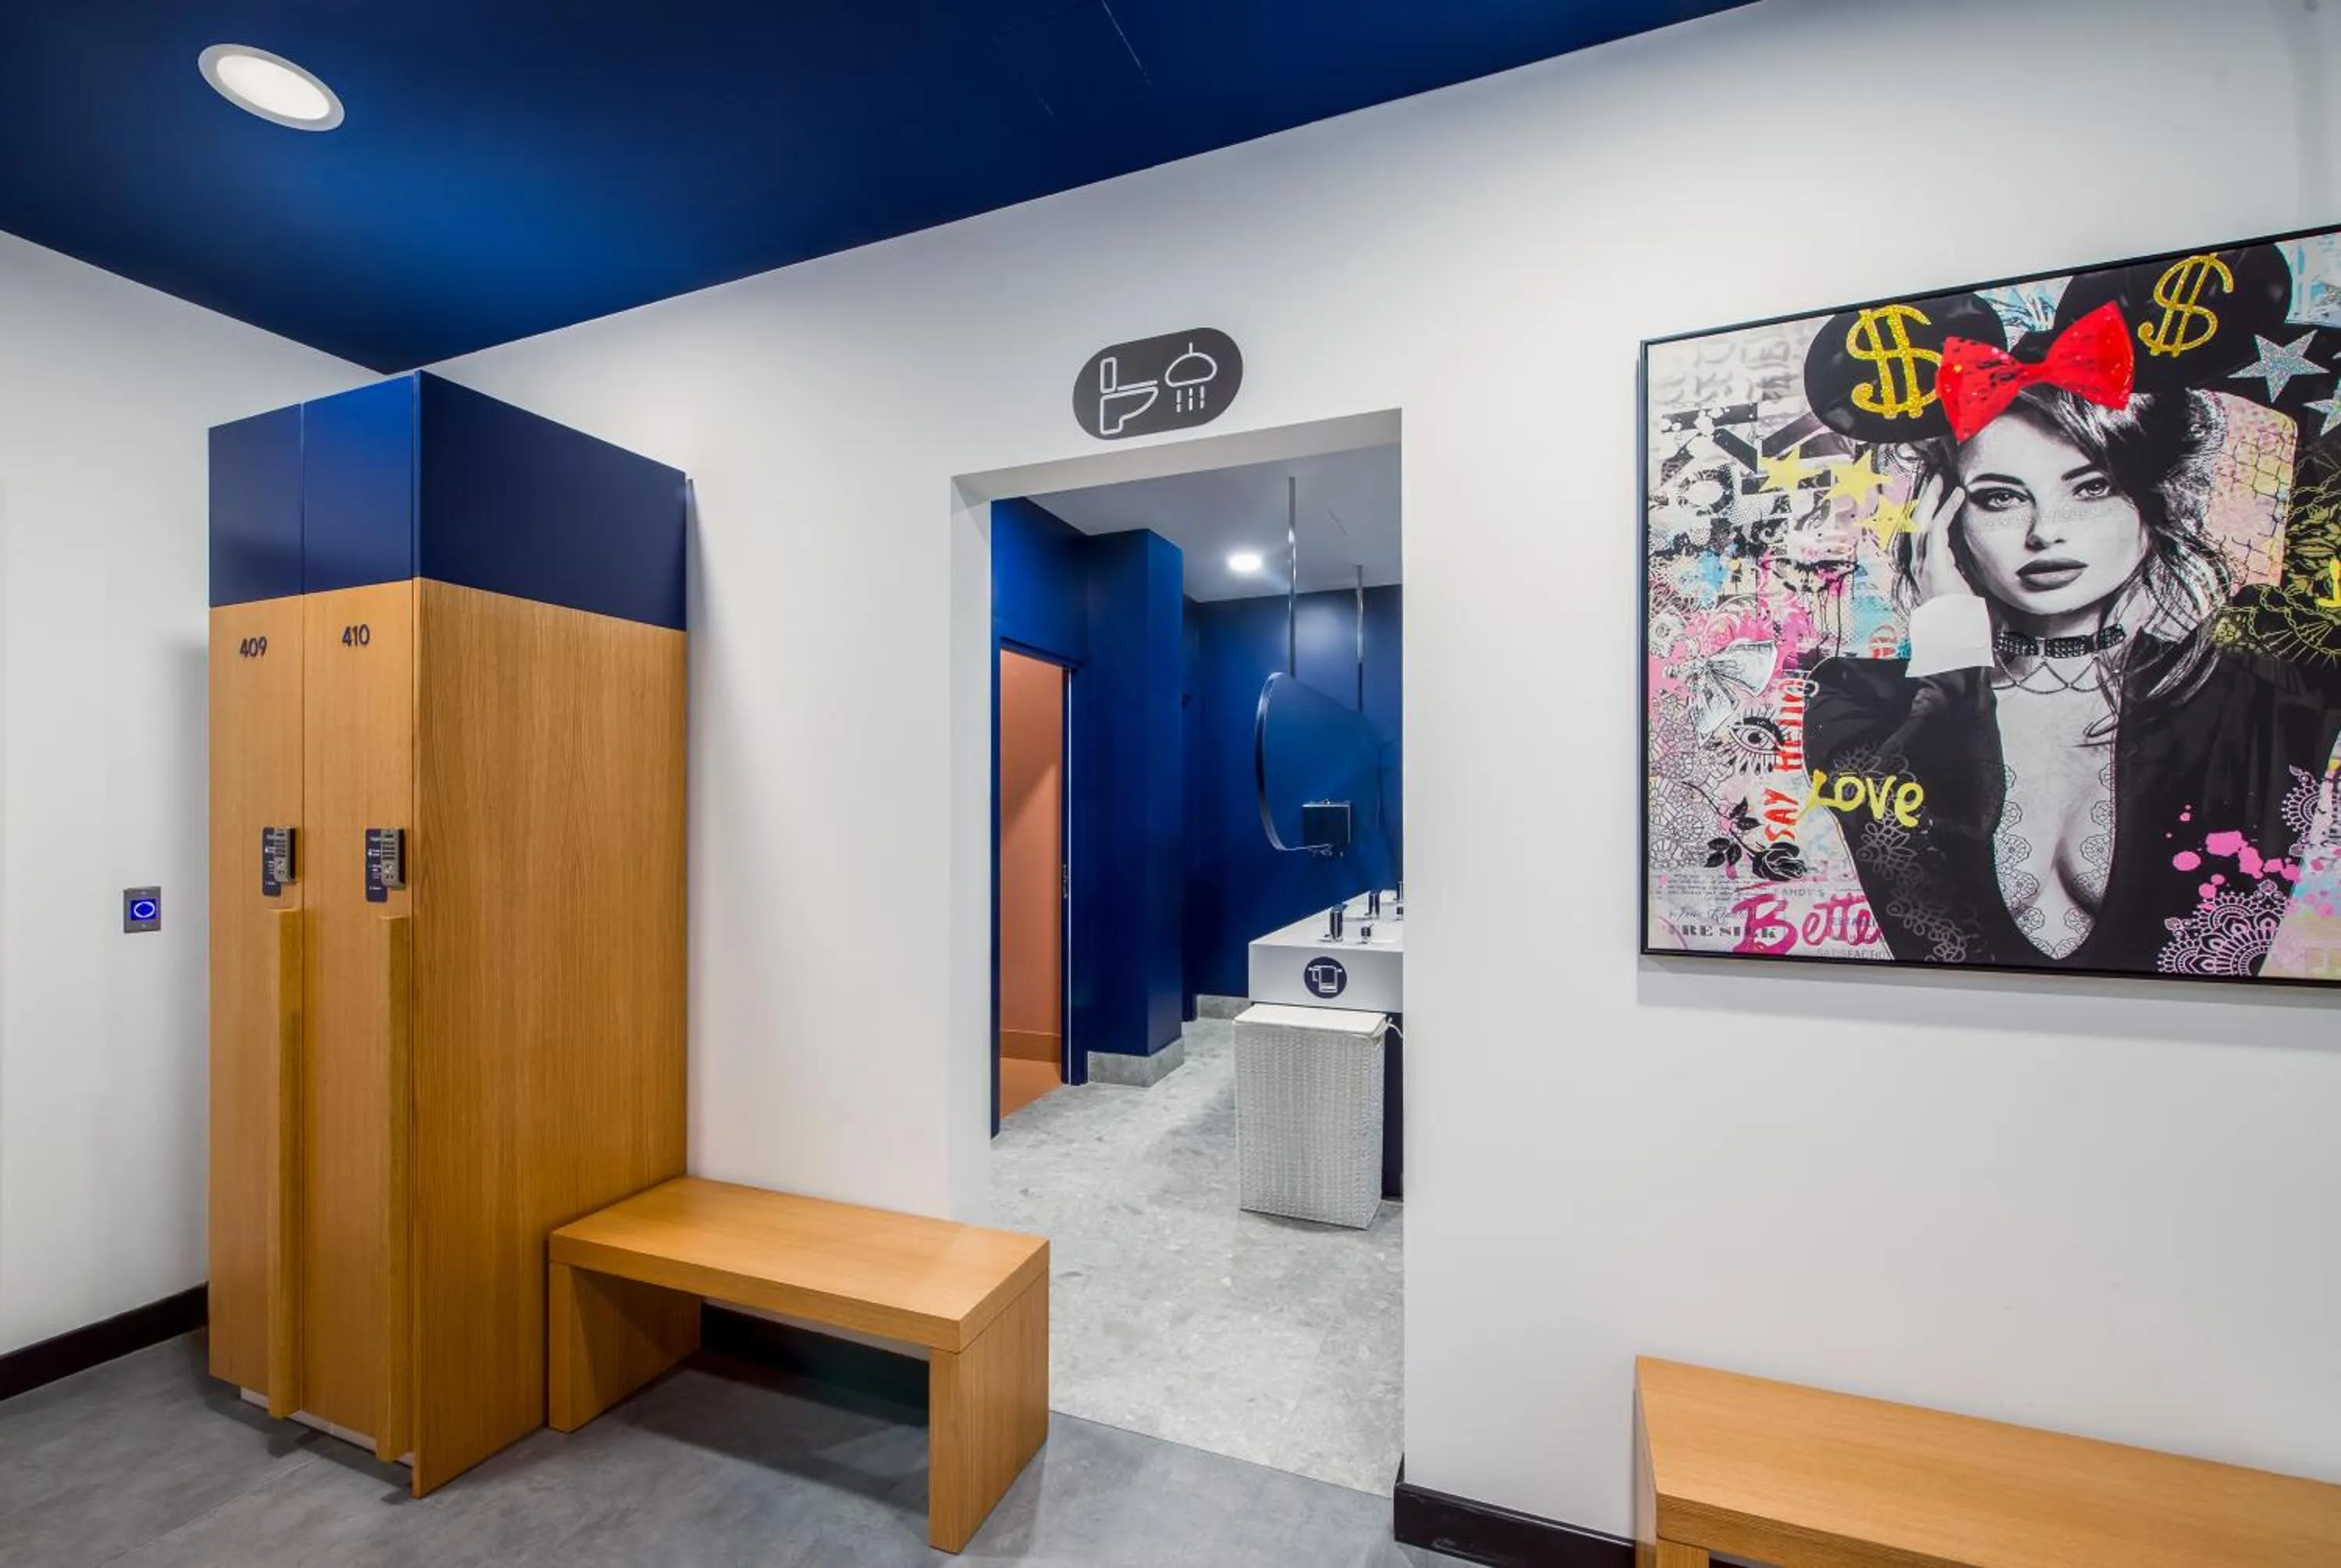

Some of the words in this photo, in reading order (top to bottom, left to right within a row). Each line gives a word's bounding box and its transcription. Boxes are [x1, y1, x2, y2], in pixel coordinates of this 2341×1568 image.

[240, 636, 268, 658] 409
[341, 623, 371, 647] 410
[1764, 788, 1799, 842] SAY
